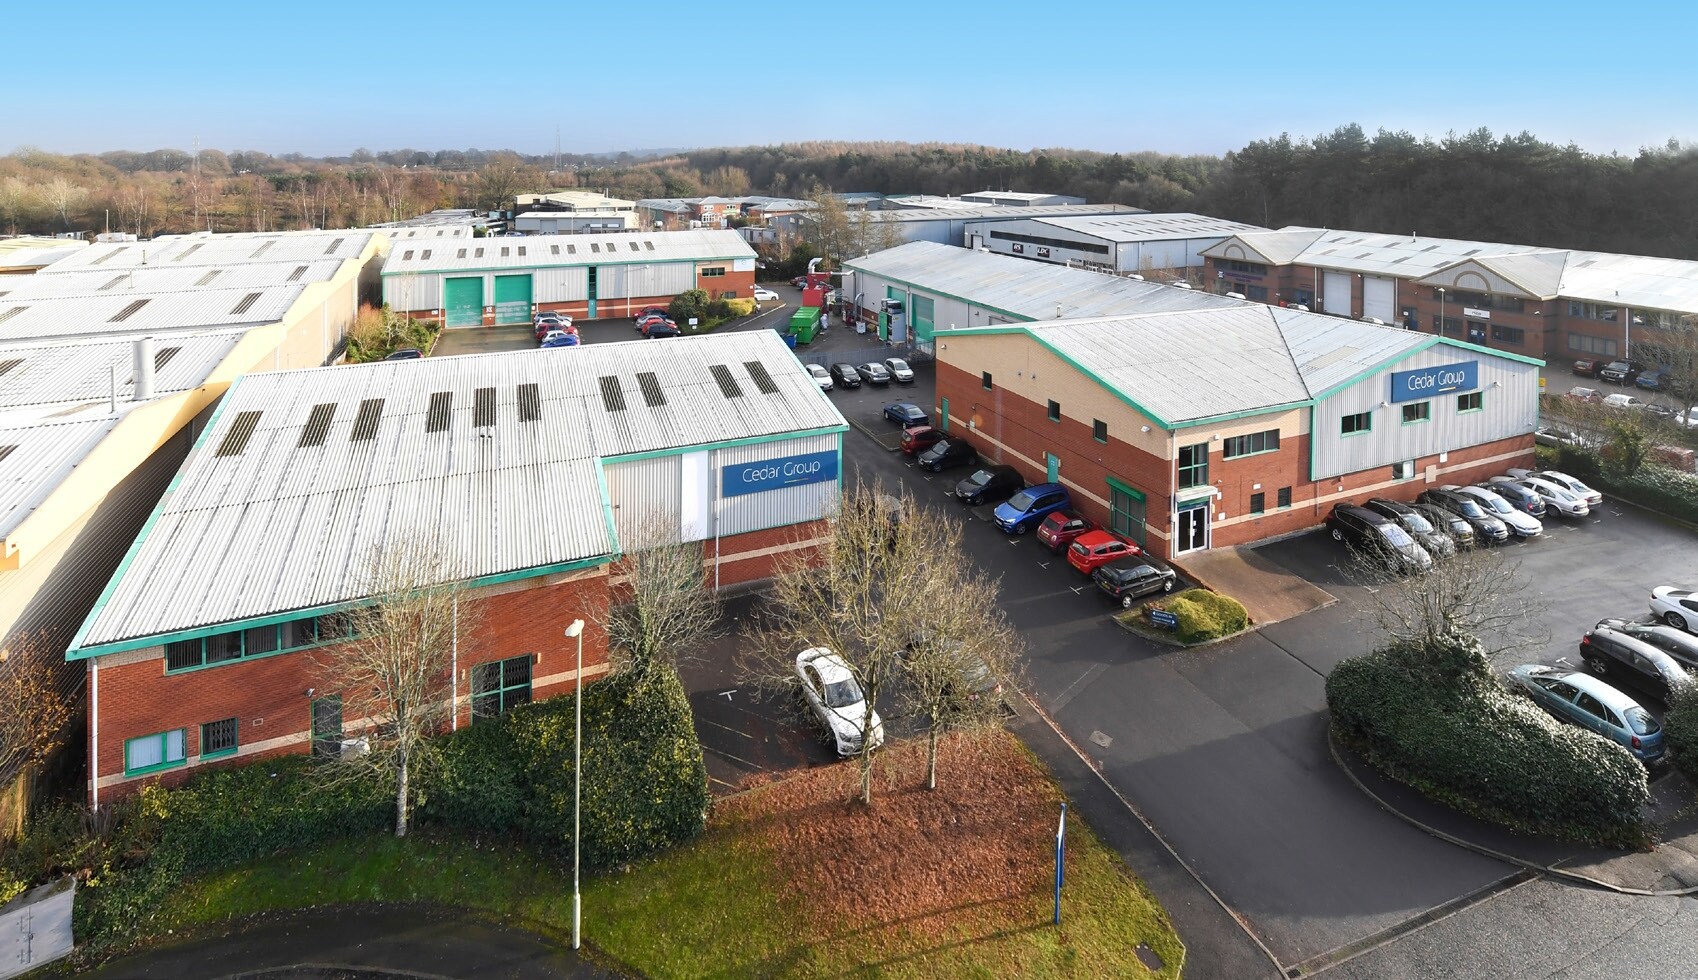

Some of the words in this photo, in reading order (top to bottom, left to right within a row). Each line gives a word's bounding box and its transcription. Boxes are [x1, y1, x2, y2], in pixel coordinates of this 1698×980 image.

[1408, 372, 1436, 390] Cedar
[1437, 370, 1465, 385] Group
[742, 465, 780, 482] Cedar
[783, 460, 820, 476] Group
